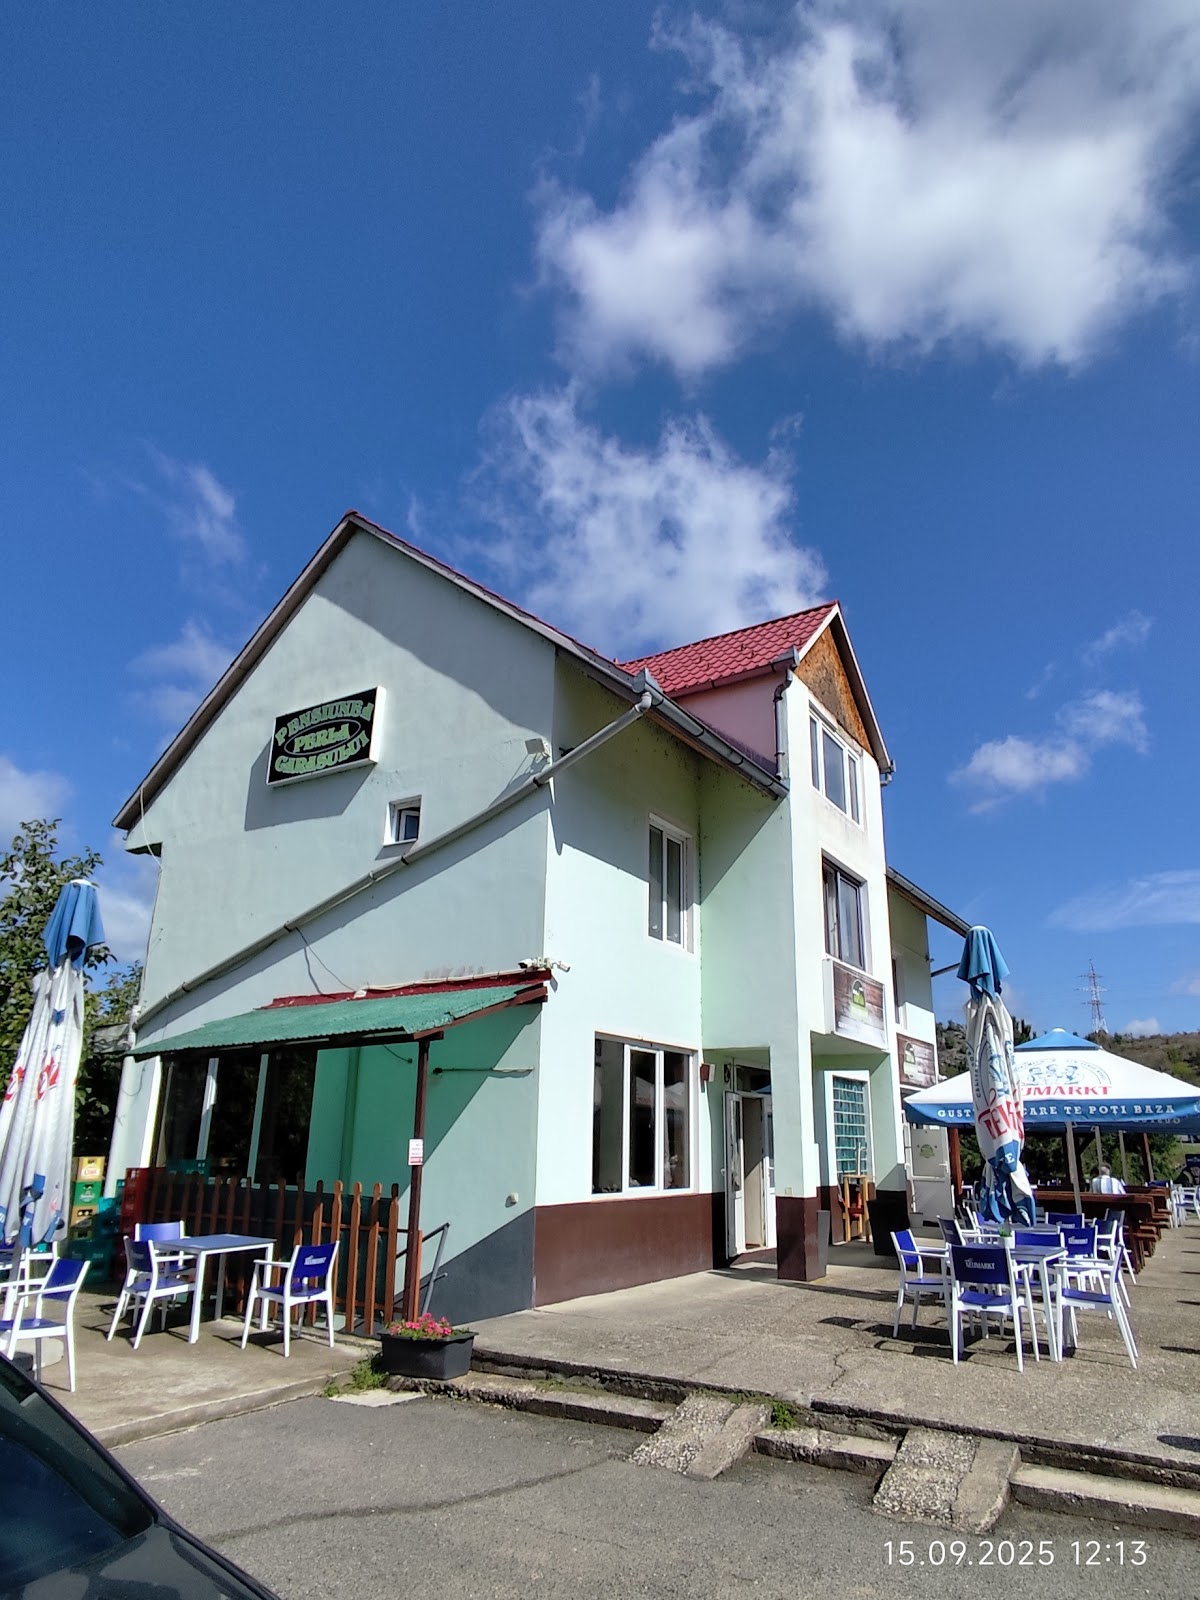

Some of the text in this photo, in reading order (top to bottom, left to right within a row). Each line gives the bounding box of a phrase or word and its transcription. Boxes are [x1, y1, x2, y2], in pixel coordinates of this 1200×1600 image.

[275, 700, 374, 746] PENSIUNEA
[293, 723, 351, 753] PERLA
[937, 1109, 975, 1118] GUST
[1064, 1106, 1082, 1115] TE
[1089, 1105, 1127, 1116] POȚI
[1134, 1104, 1175, 1114] BAZA
